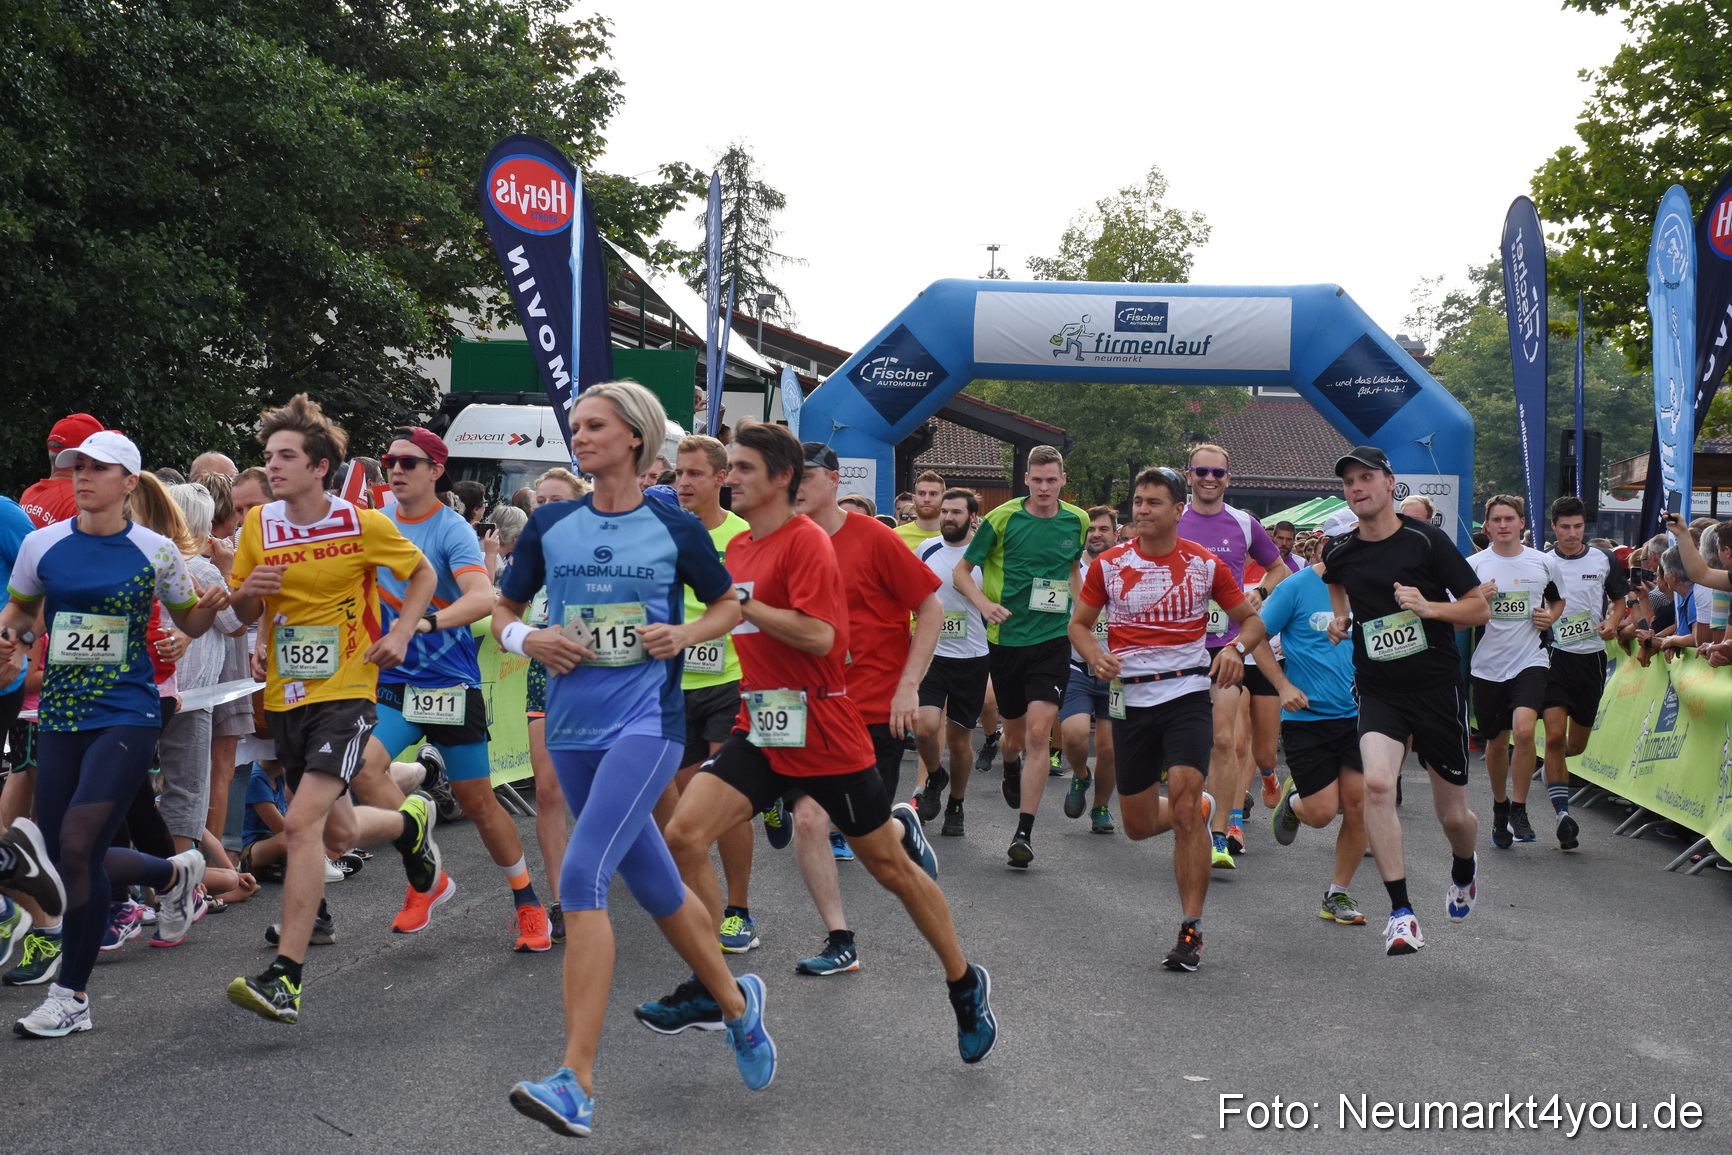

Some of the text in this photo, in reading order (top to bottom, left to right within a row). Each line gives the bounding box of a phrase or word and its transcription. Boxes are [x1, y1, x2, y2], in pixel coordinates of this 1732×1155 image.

[1126, 313, 1165, 322] Fischer
[1095, 333, 1213, 355] firmenlauf
[1094, 355, 1142, 363] neumarkt
[872, 368, 934, 380] Fischer
[1335, 378, 1352, 387] und
[1354, 376, 1372, 384] das
[1357, 385, 1406, 398] fährt mit!
[454, 432, 506, 442] abavent
[264, 543, 364, 567] MAX BÖGL
[553, 564, 655, 580] SCHABMÜLLER
[586, 583, 612, 592] TEAM
[1048, 592, 1056, 603] 2
[1494, 602, 1525, 612] 2369
[591, 626, 636, 649] 115
[1560, 622, 1590, 638] 2282
[66, 632, 110, 651] 244
[1372, 626, 1418, 652] 2002
[281, 645, 328, 664] 1582
[688, 646, 718, 662] 760
[412, 695, 455, 712] 1911
[758, 711, 788, 731] 509
